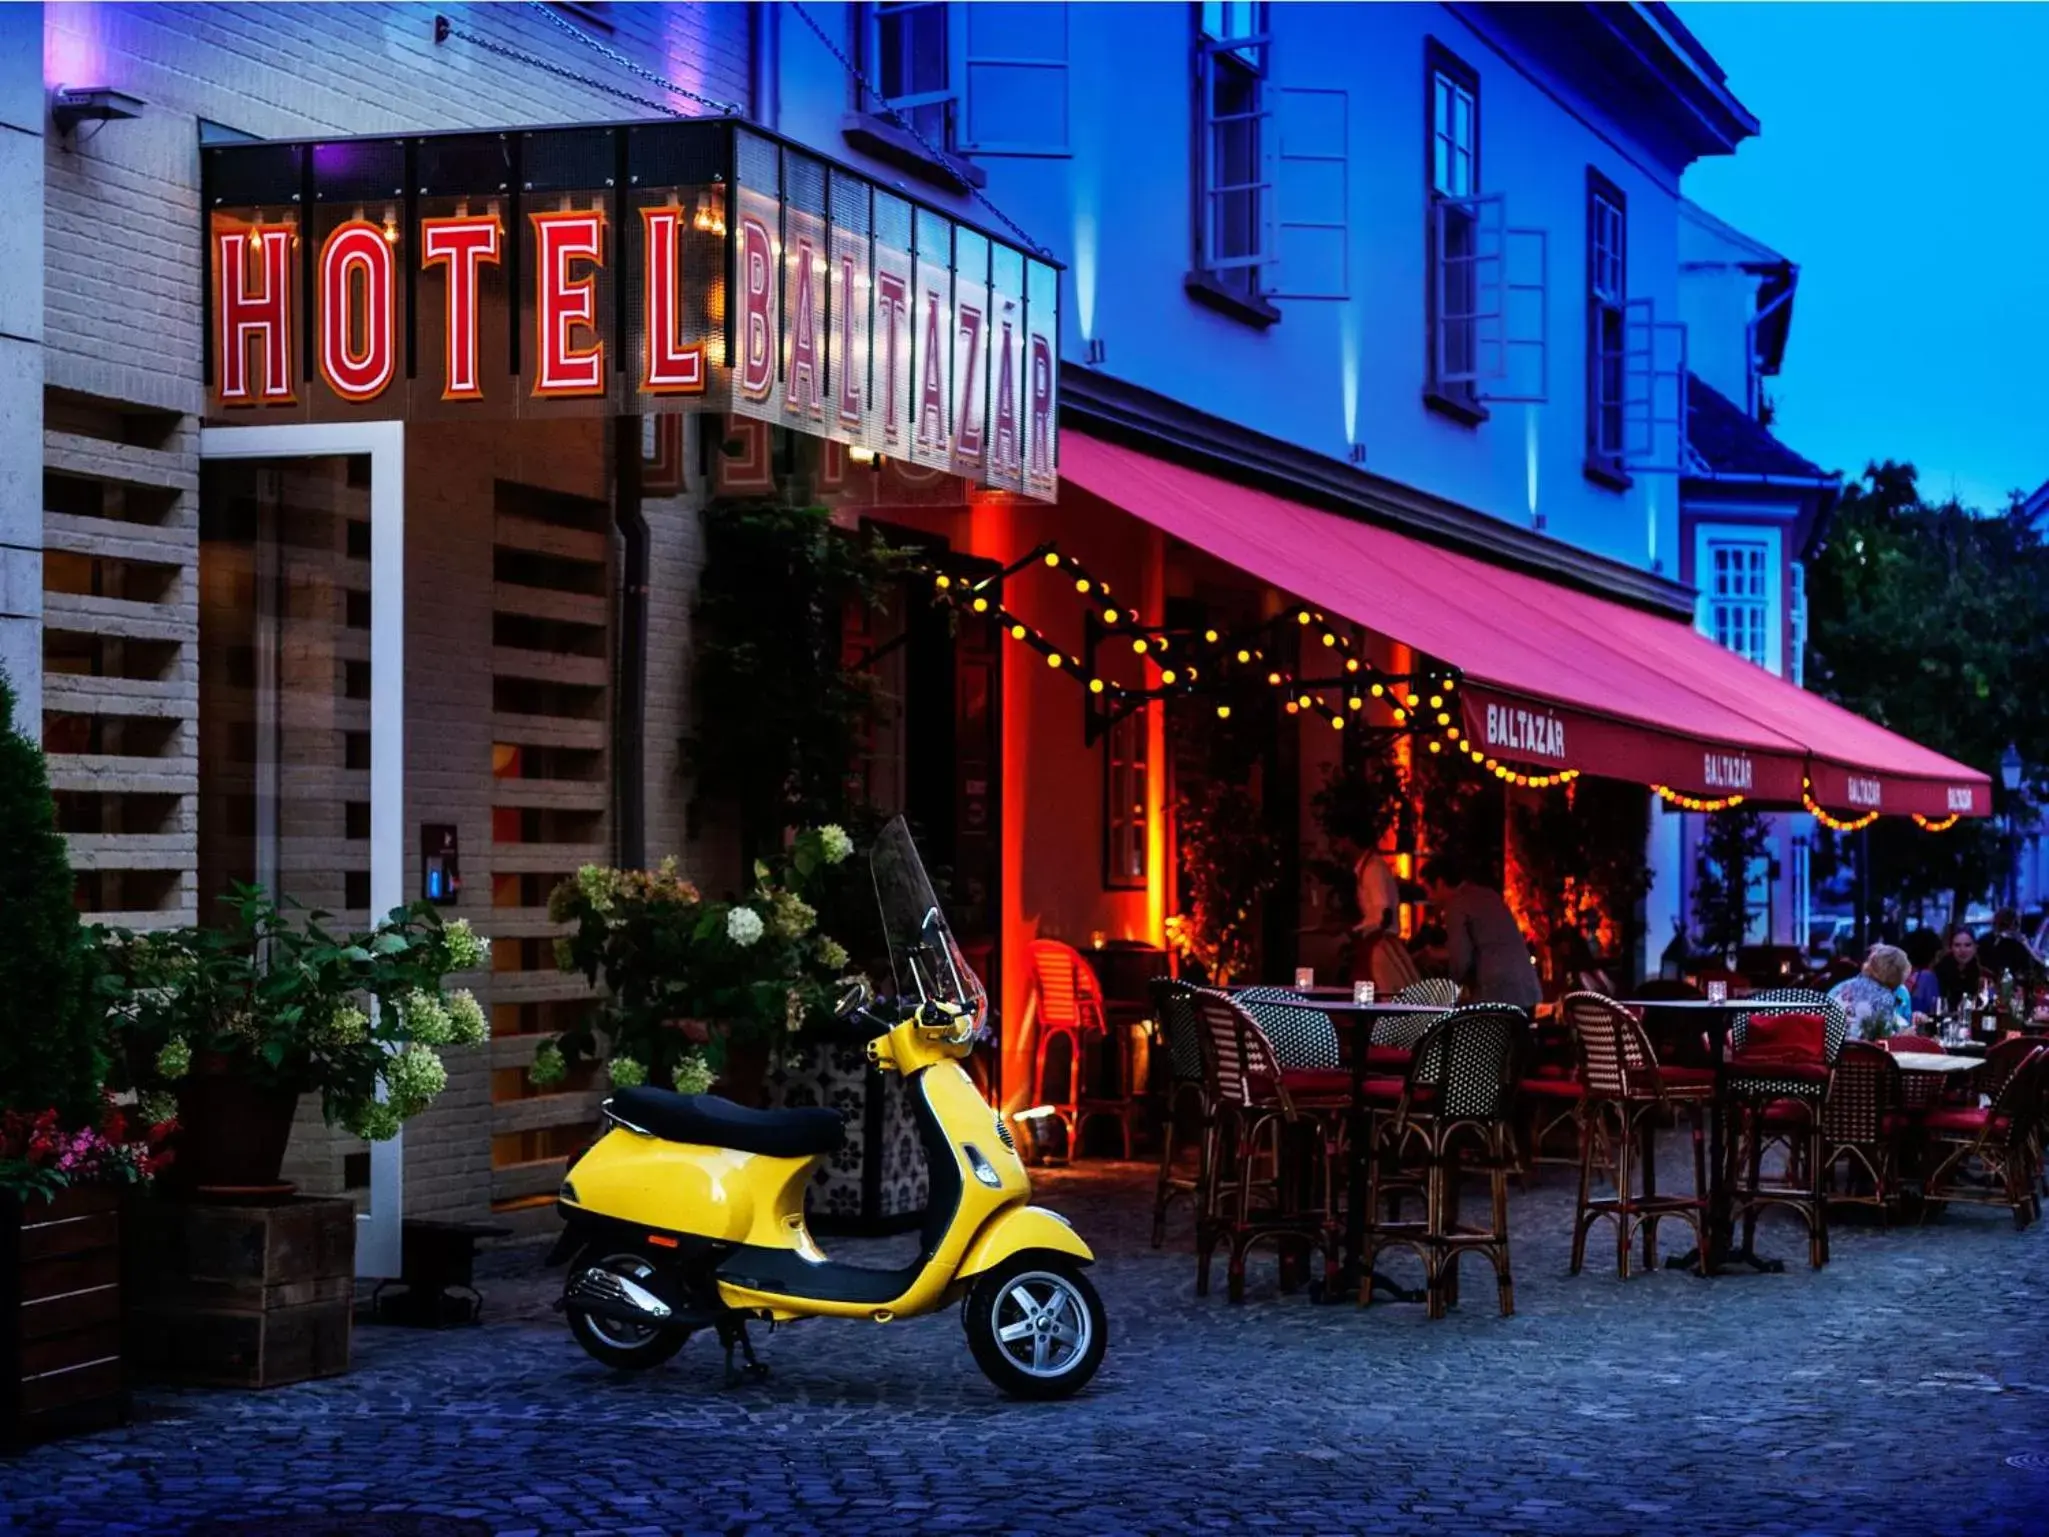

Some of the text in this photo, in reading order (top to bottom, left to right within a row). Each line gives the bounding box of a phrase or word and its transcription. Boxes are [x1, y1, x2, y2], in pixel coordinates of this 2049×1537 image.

[213, 206, 1054, 490] HOTEL BALTAZÁR
[1487, 704, 1565, 760] BALTAZÁR
